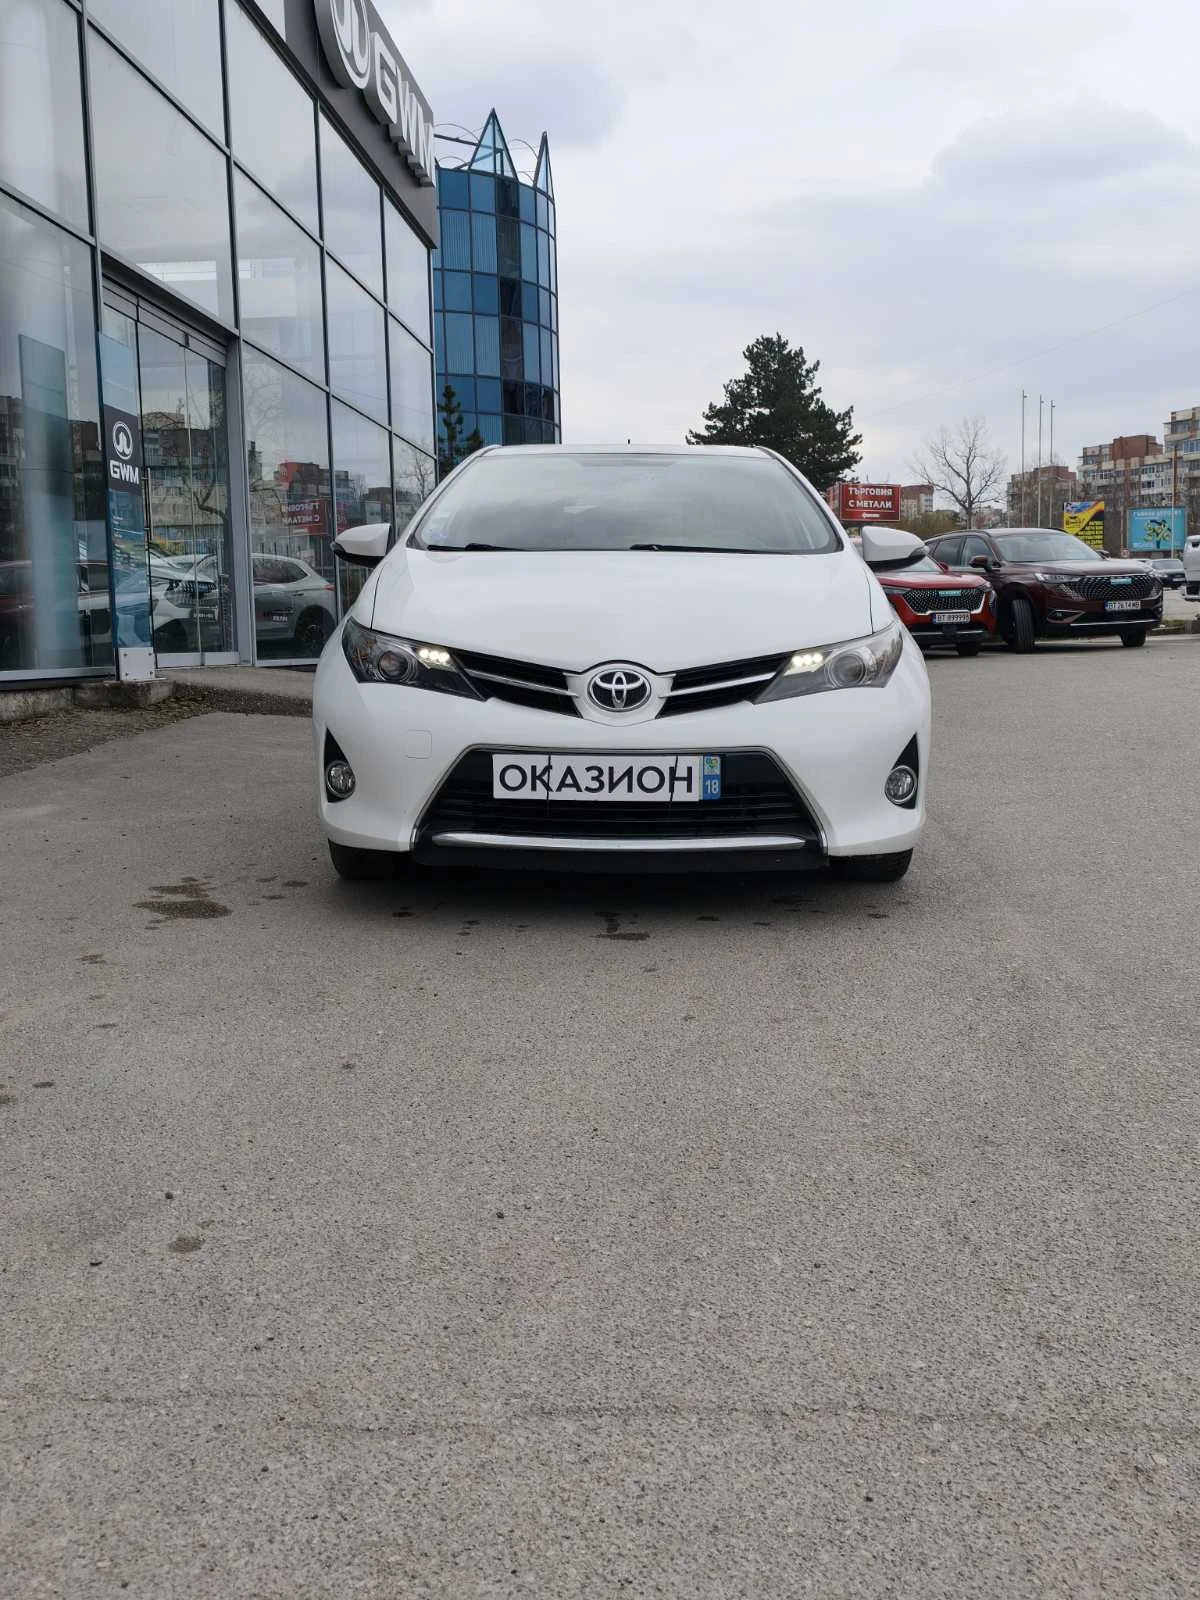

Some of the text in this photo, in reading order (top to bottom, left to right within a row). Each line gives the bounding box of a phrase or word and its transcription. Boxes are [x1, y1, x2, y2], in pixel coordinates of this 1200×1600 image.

[373, 32, 435, 188] GWM
[110, 459, 139, 485] GWM
[848, 487, 893, 496] ТЪРГОВИЯ
[848, 500, 892, 508] С МЕТАЛИ
[499, 763, 693, 794] ОКАЗИОН
[705, 779, 719, 794] 18
